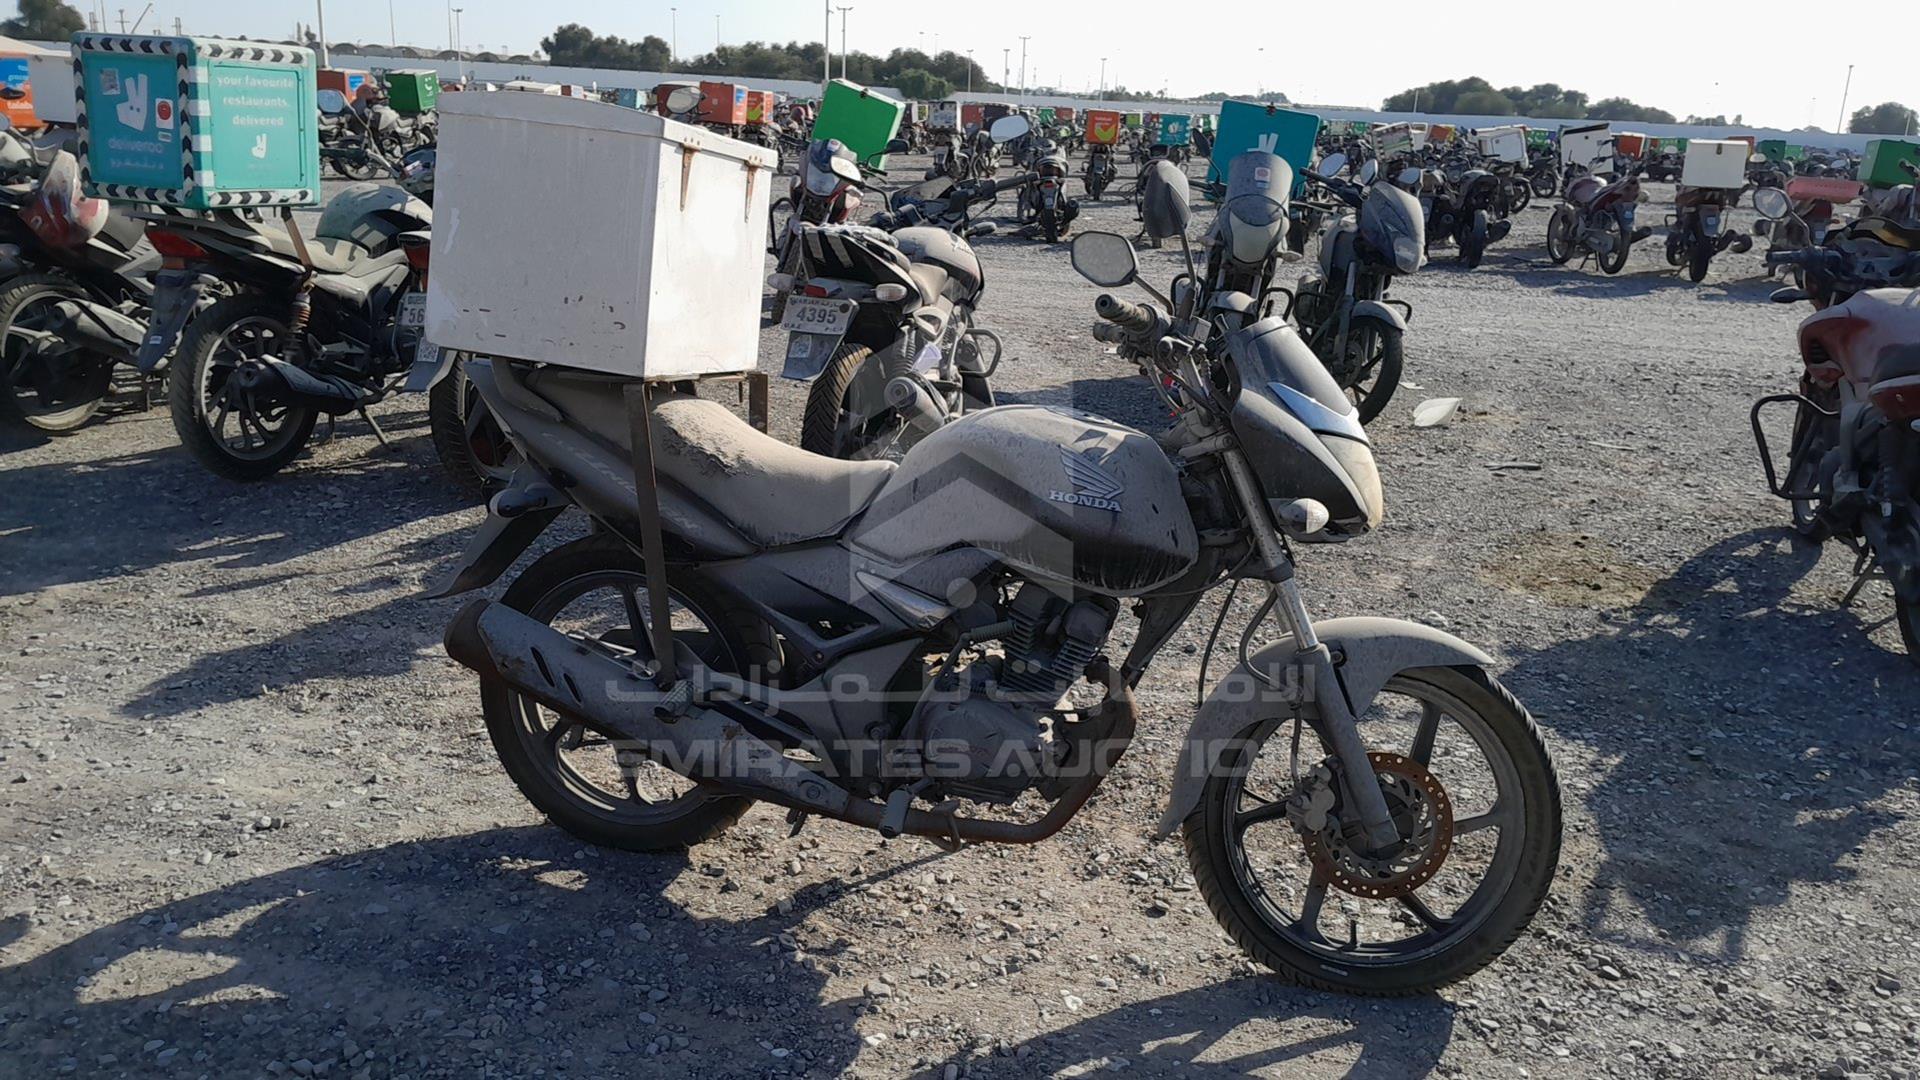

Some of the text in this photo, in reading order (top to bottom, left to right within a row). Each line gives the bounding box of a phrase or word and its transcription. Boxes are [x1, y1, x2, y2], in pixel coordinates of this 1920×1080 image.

[217, 75, 294, 88] your favourite
[232, 114, 284, 126] delivered
[796, 306, 836, 324] 4395
[1048, 489, 1122, 512] HONDA
